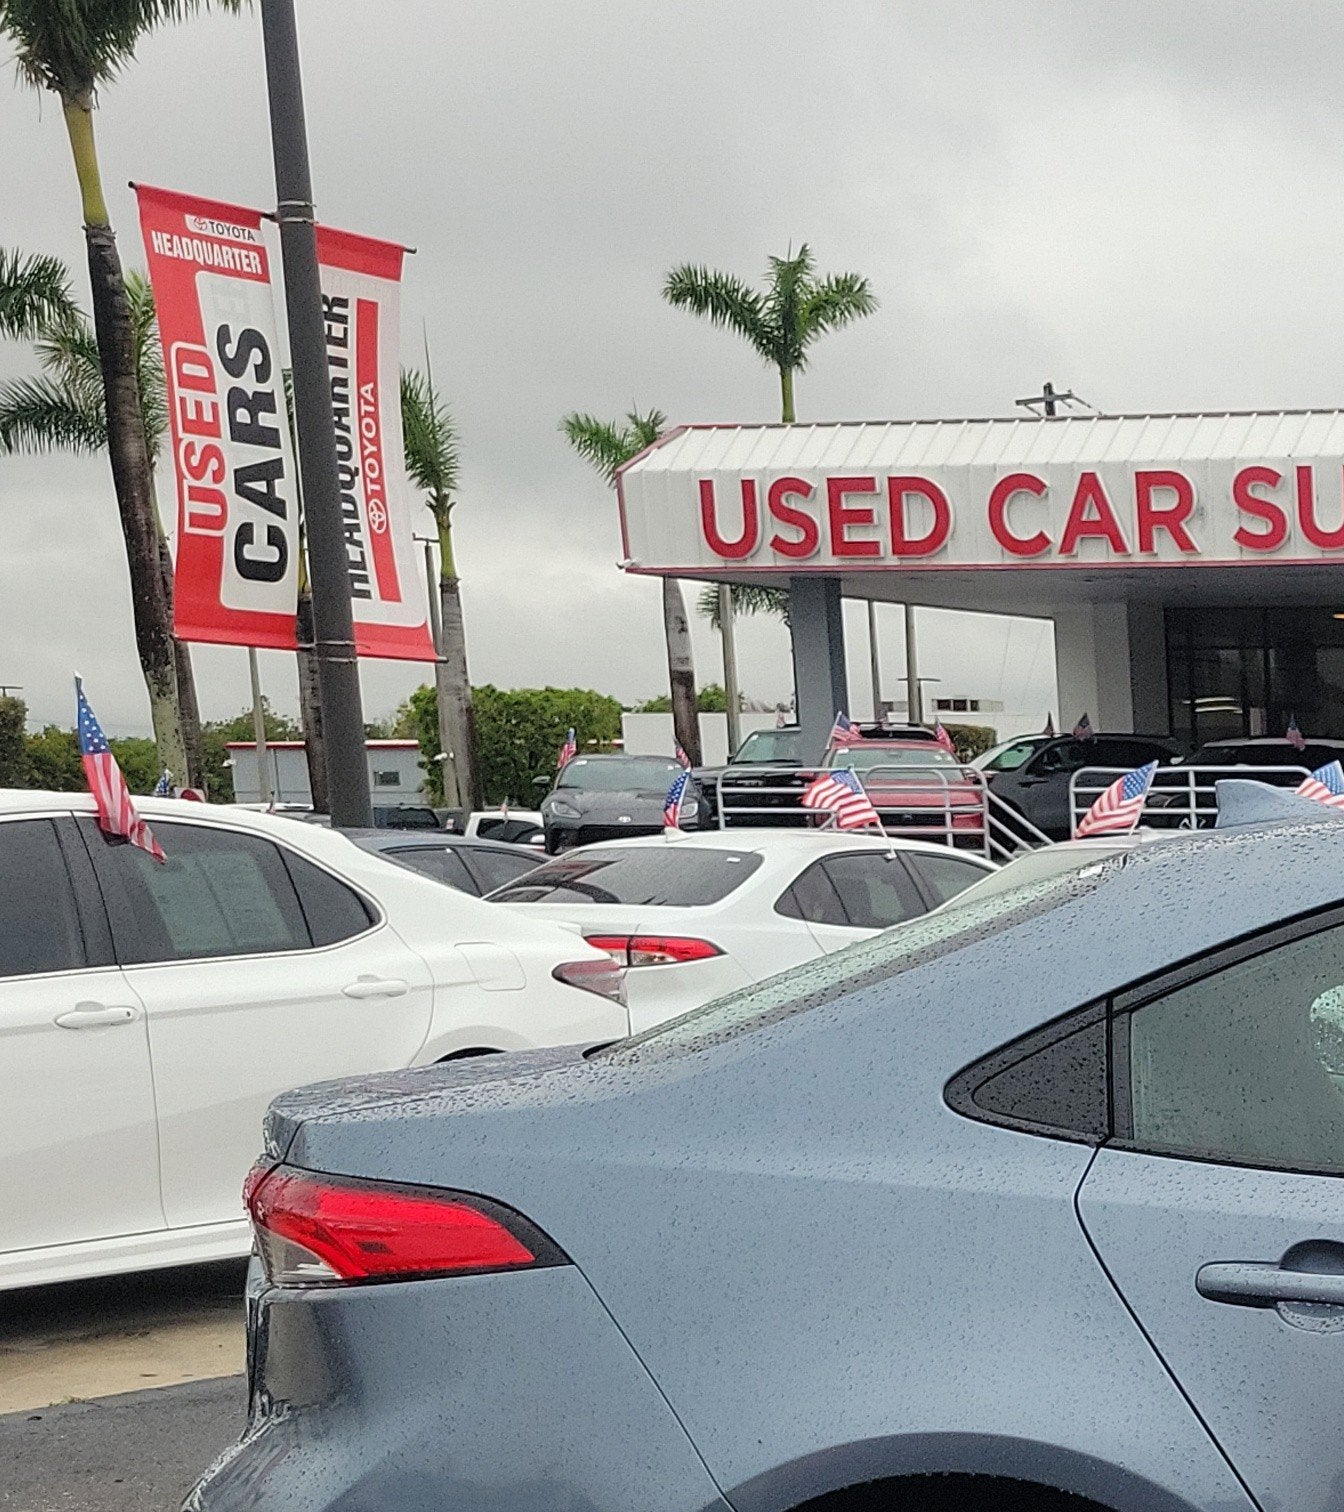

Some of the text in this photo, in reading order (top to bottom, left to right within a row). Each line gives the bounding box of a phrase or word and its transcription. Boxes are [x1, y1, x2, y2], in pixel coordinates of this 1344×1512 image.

[151, 229, 263, 275] HEADQUARTER
[208, 220, 256, 242] TOYOTA
[174, 345, 229, 534] USED
[216, 323, 289, 583] CARS
[360, 381, 382, 495] TOYOTA
[699, 475, 951, 560] USED
[988, 470, 1197, 557] CAR
